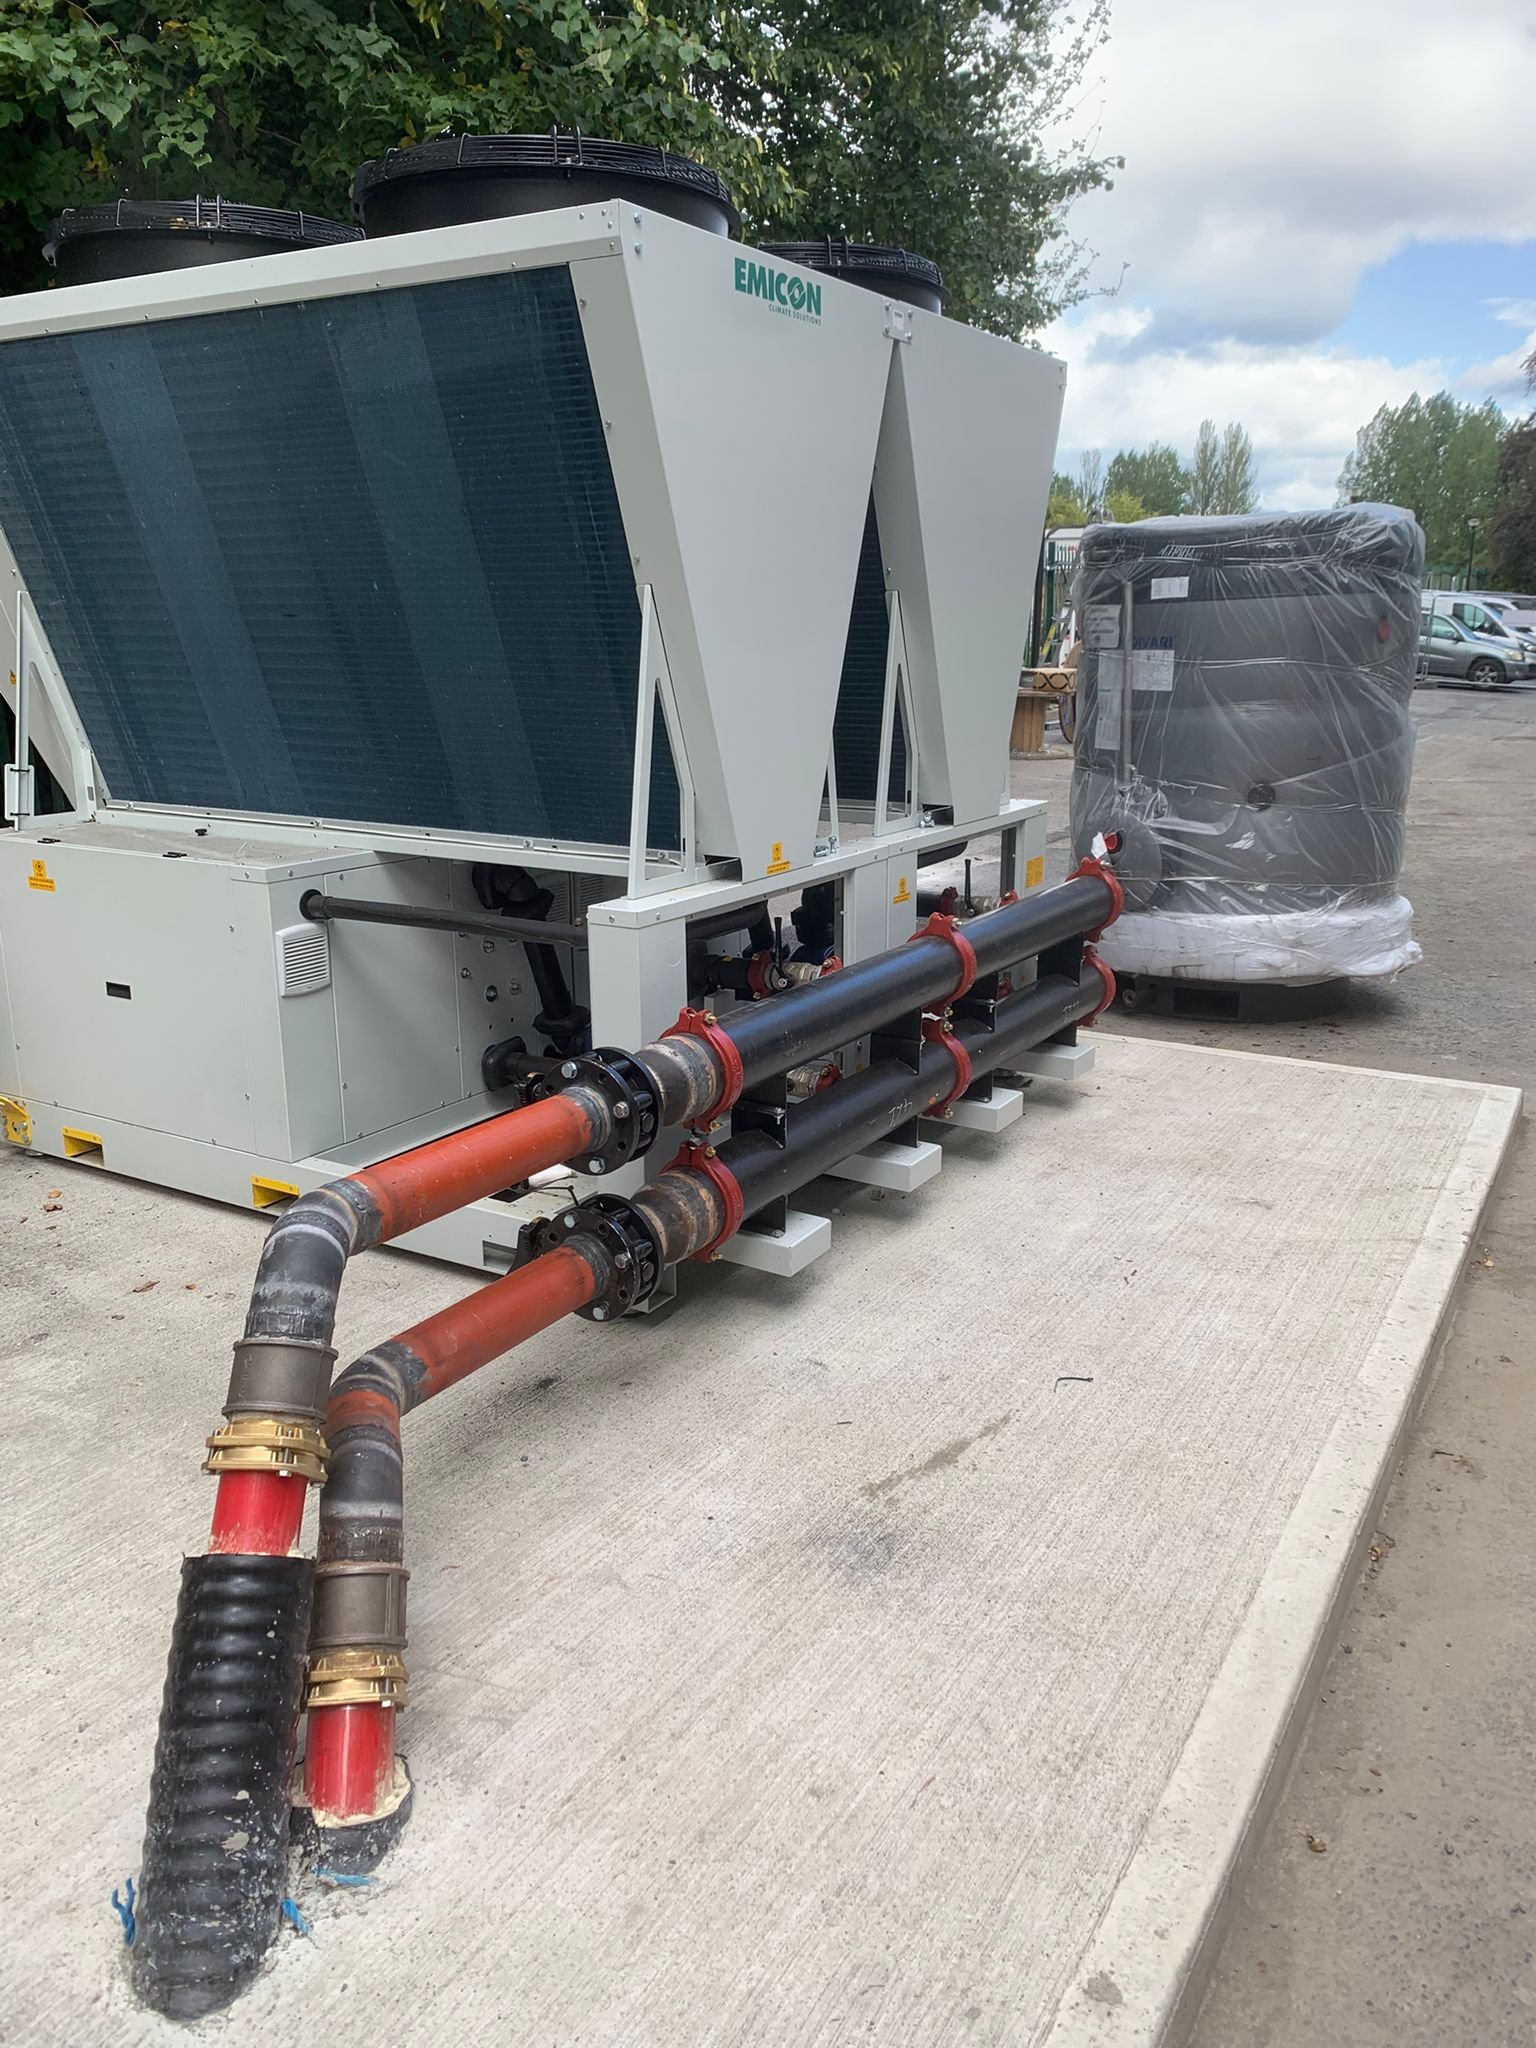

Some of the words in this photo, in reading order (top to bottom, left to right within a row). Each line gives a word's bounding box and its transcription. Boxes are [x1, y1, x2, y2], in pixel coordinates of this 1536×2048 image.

[734, 256, 822, 316] EMICON
[768, 303, 791, 318] CLIMATE
[792, 310, 821, 326] SOLUTIONS
